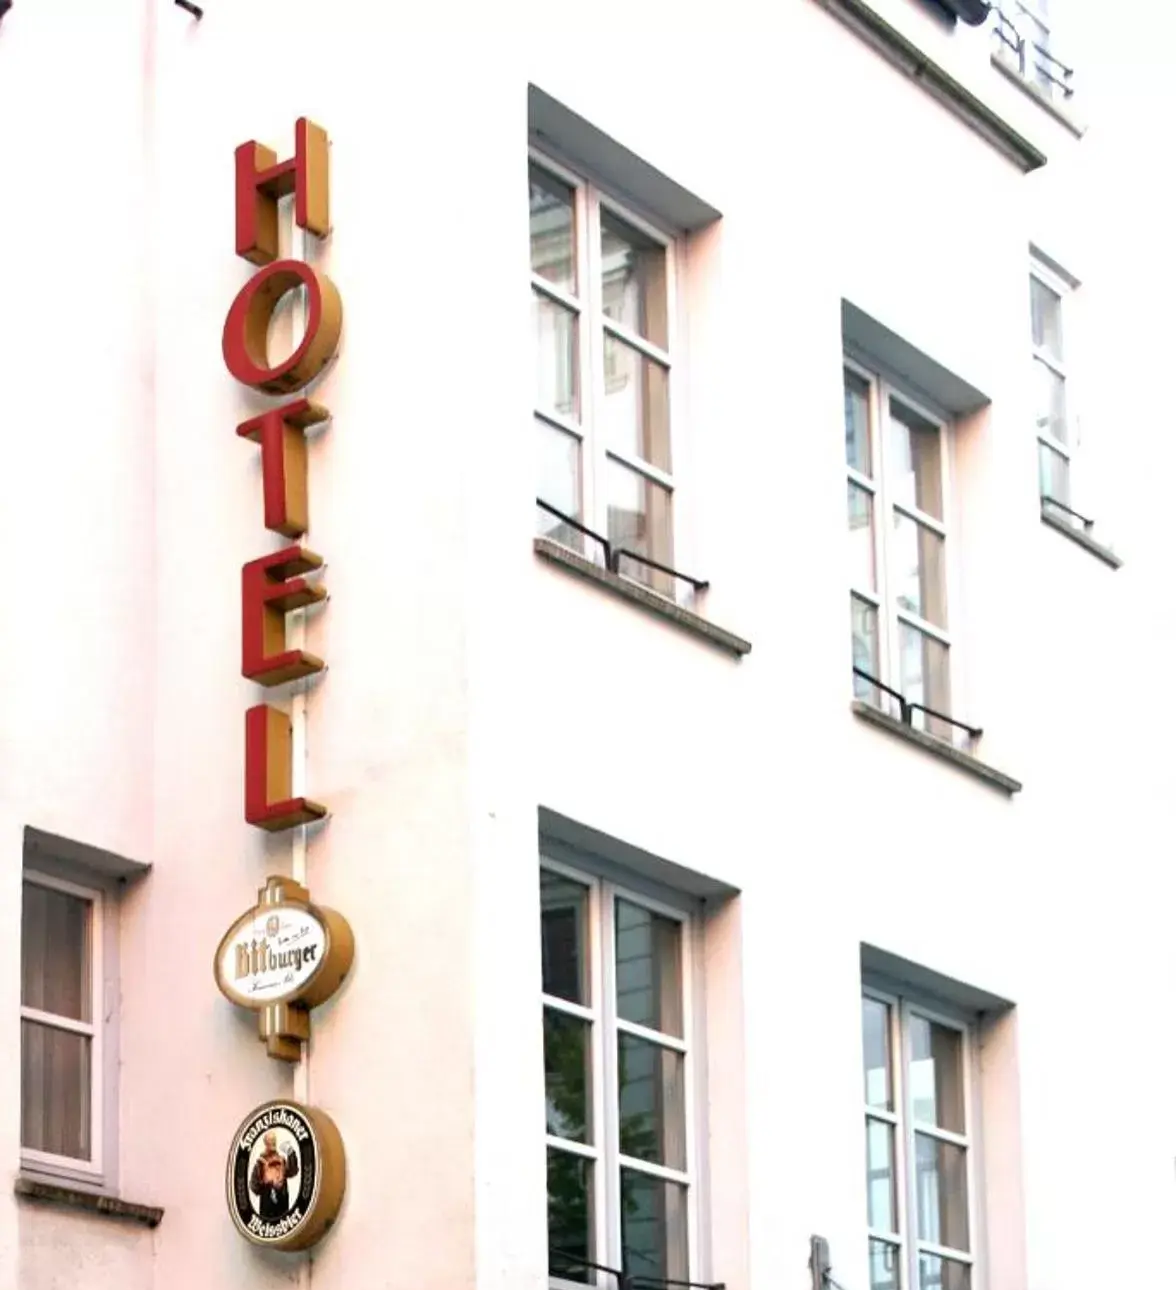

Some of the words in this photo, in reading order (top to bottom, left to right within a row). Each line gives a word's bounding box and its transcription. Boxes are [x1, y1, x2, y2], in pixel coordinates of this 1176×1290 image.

[222, 117, 342, 832] HOTEL
[234, 937, 318, 980] Bitburger
[240, 1108, 309, 1152] Franziskaner
[247, 1208, 302, 1238] Weissbier
